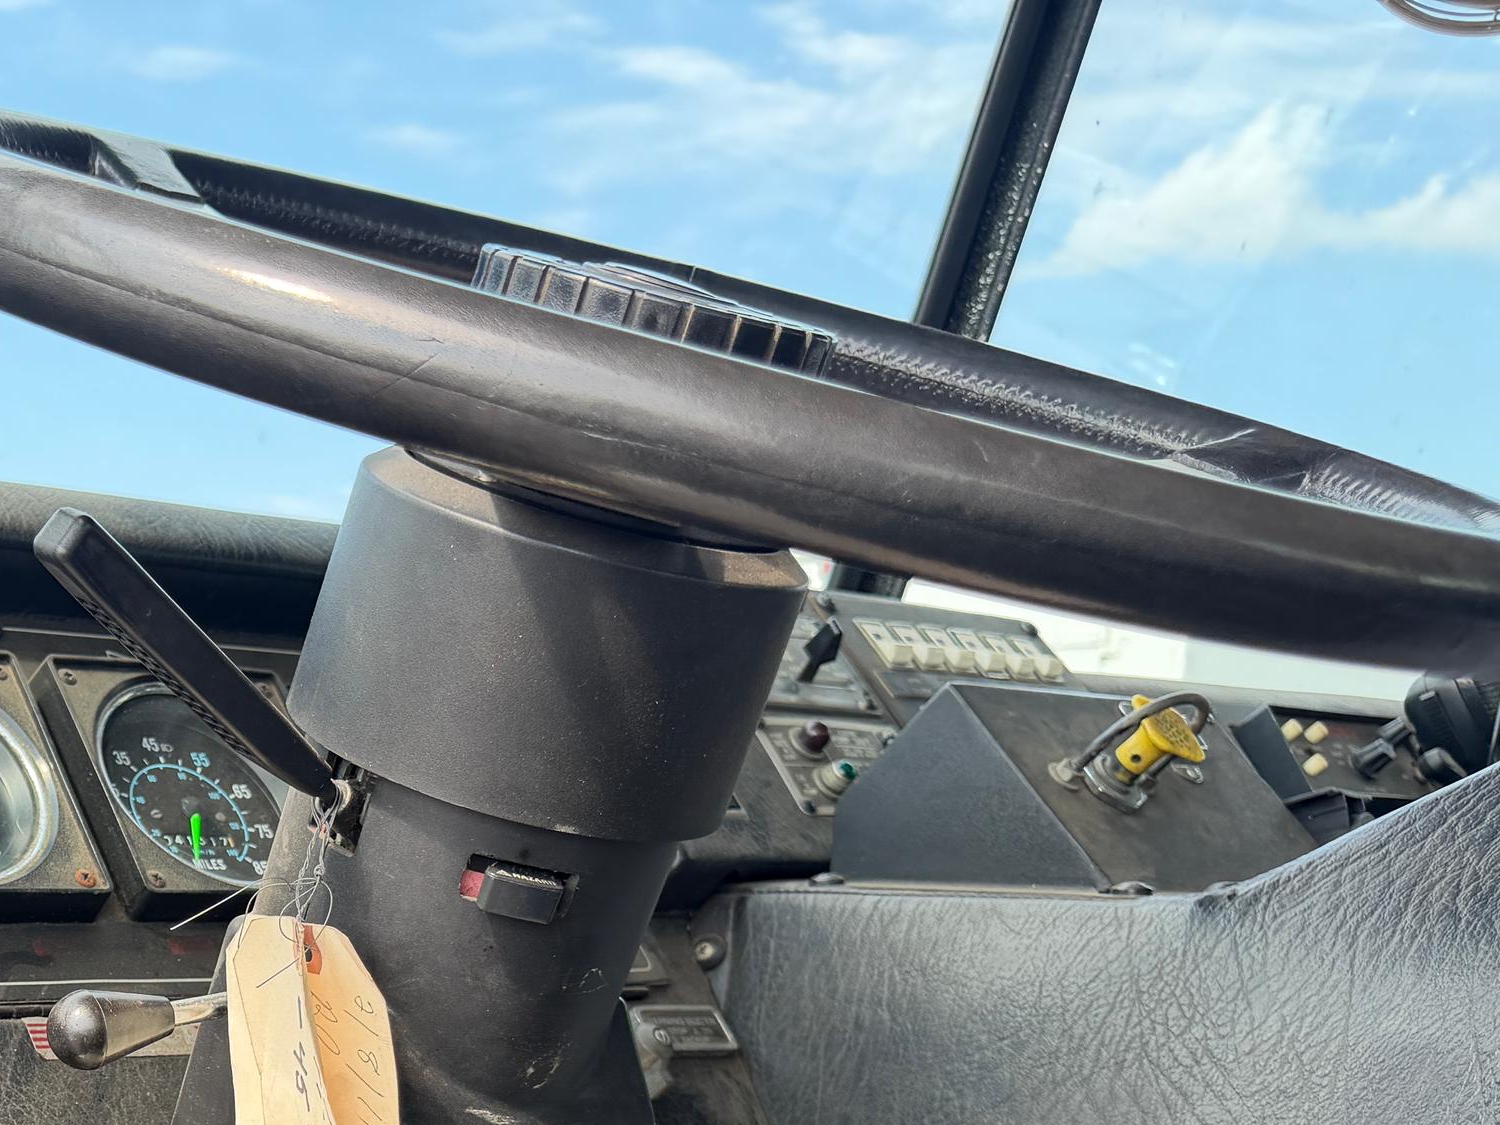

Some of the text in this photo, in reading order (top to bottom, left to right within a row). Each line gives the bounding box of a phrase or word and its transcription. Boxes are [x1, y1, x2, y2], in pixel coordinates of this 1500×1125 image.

[142, 737, 160, 753] 45
[112, 750, 132, 766] 35
[190, 752, 211, 768] 55
[232, 784, 252, 799] 65
[253, 824, 274, 839] 75
[192, 858, 228, 871] MILES
